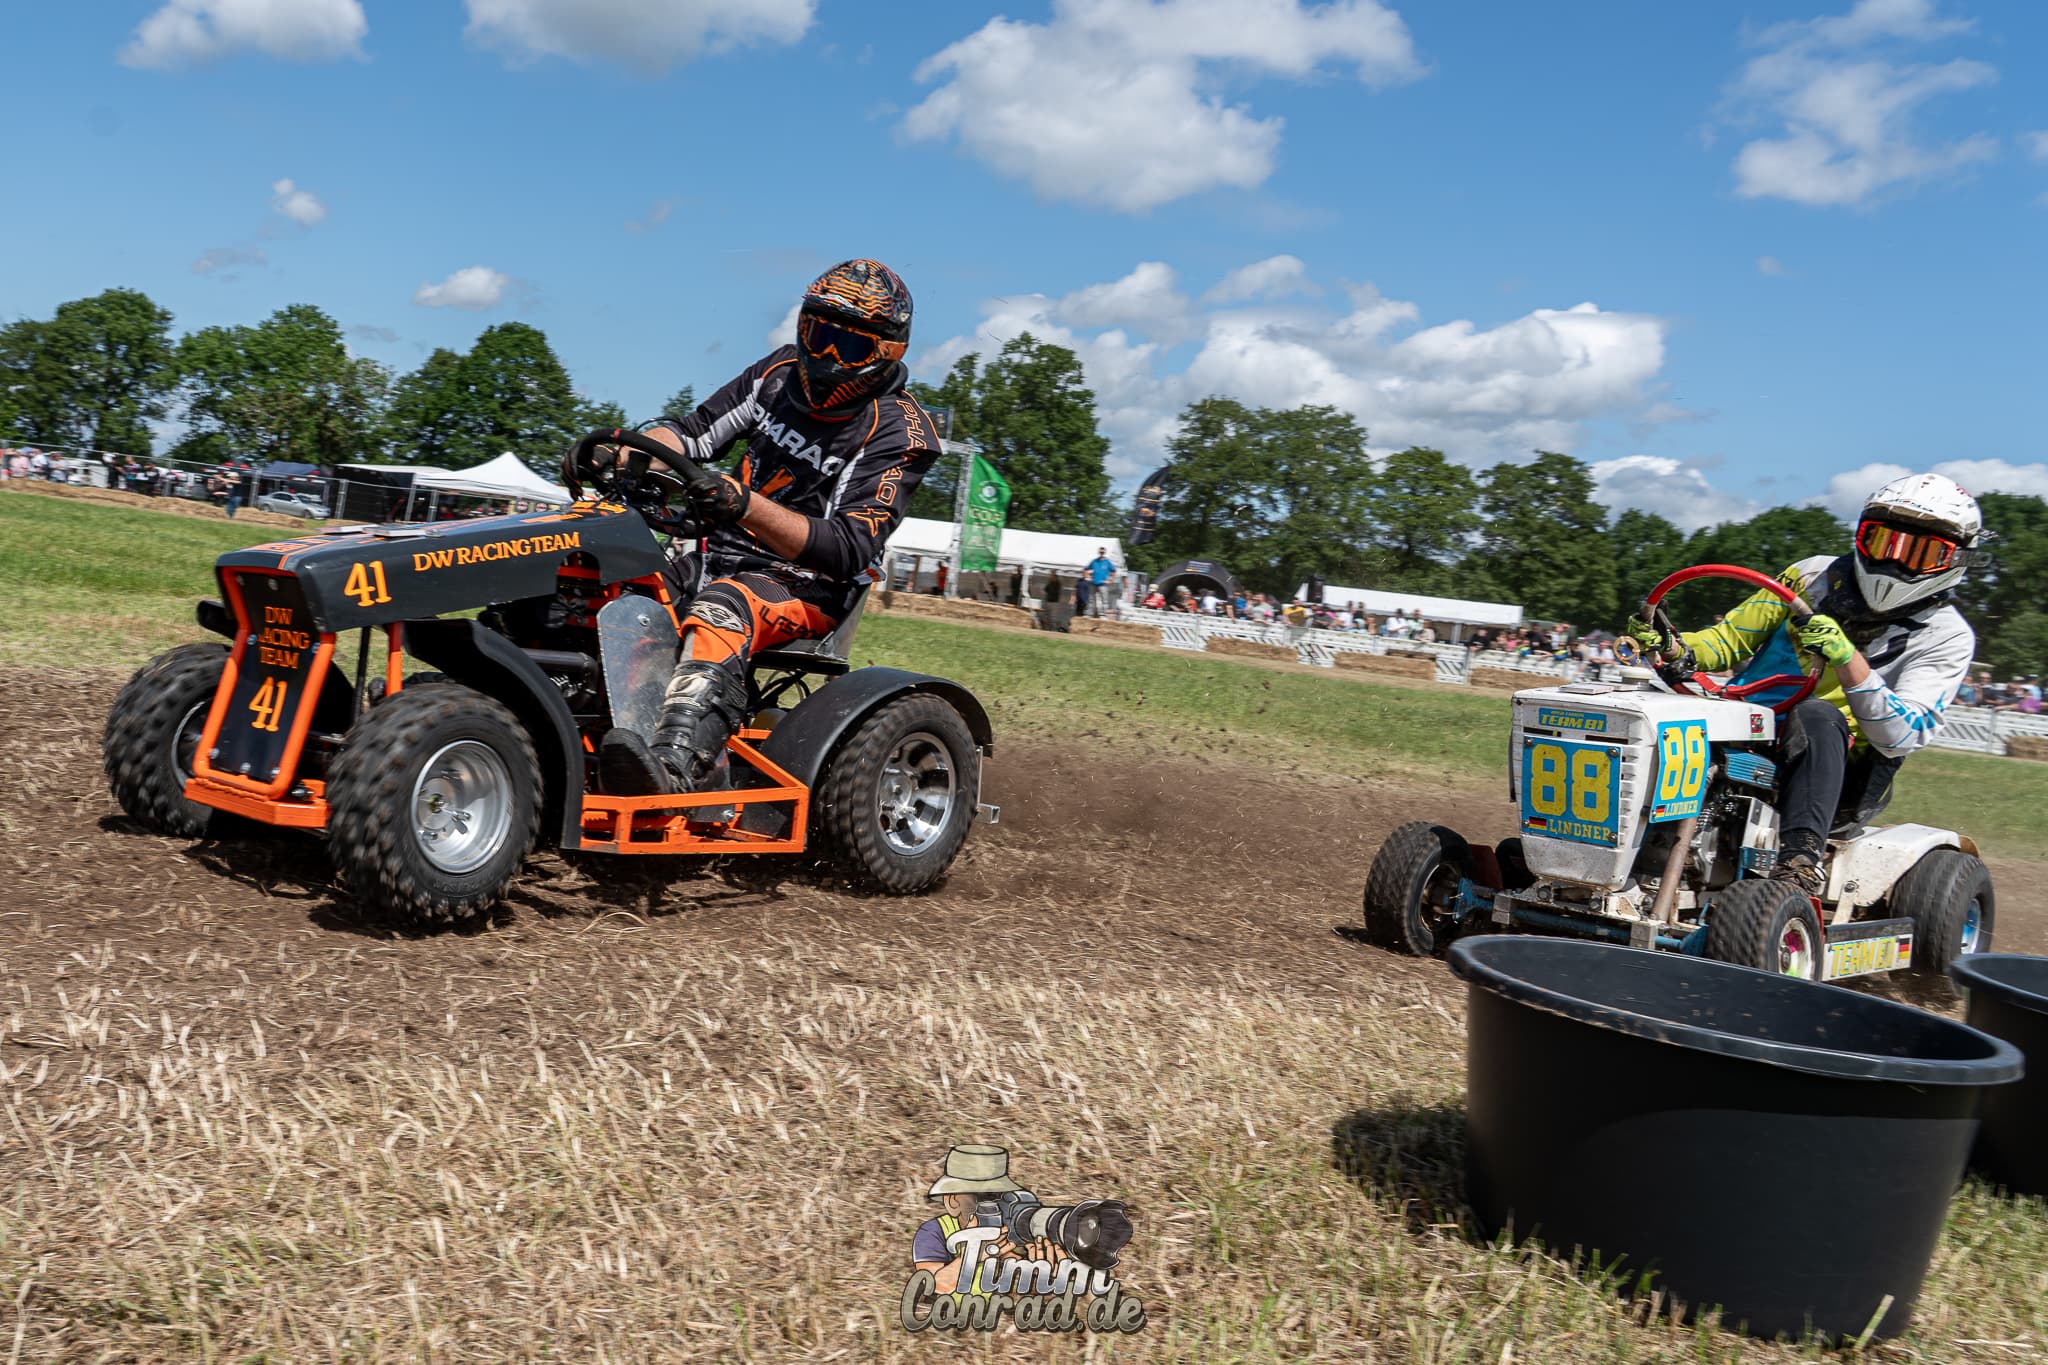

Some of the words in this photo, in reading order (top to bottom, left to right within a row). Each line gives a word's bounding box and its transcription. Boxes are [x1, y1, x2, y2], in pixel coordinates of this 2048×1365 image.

[413, 549, 455, 572] DW
[456, 537, 531, 566] RACING
[530, 531, 581, 555] TEAM
[343, 560, 393, 607] 41
[264, 606, 293, 625] DW
[260, 646, 300, 669] TEAM
[248, 676, 288, 732] 41
[1541, 713, 1582, 730] TEAM
[1660, 726, 1706, 800] 88
[1531, 744, 1611, 823] 88
[1664, 800, 1699, 817] LINDNER
[1549, 818, 1612, 841] LINDNER
[1829, 940, 1876, 977] TEAM
